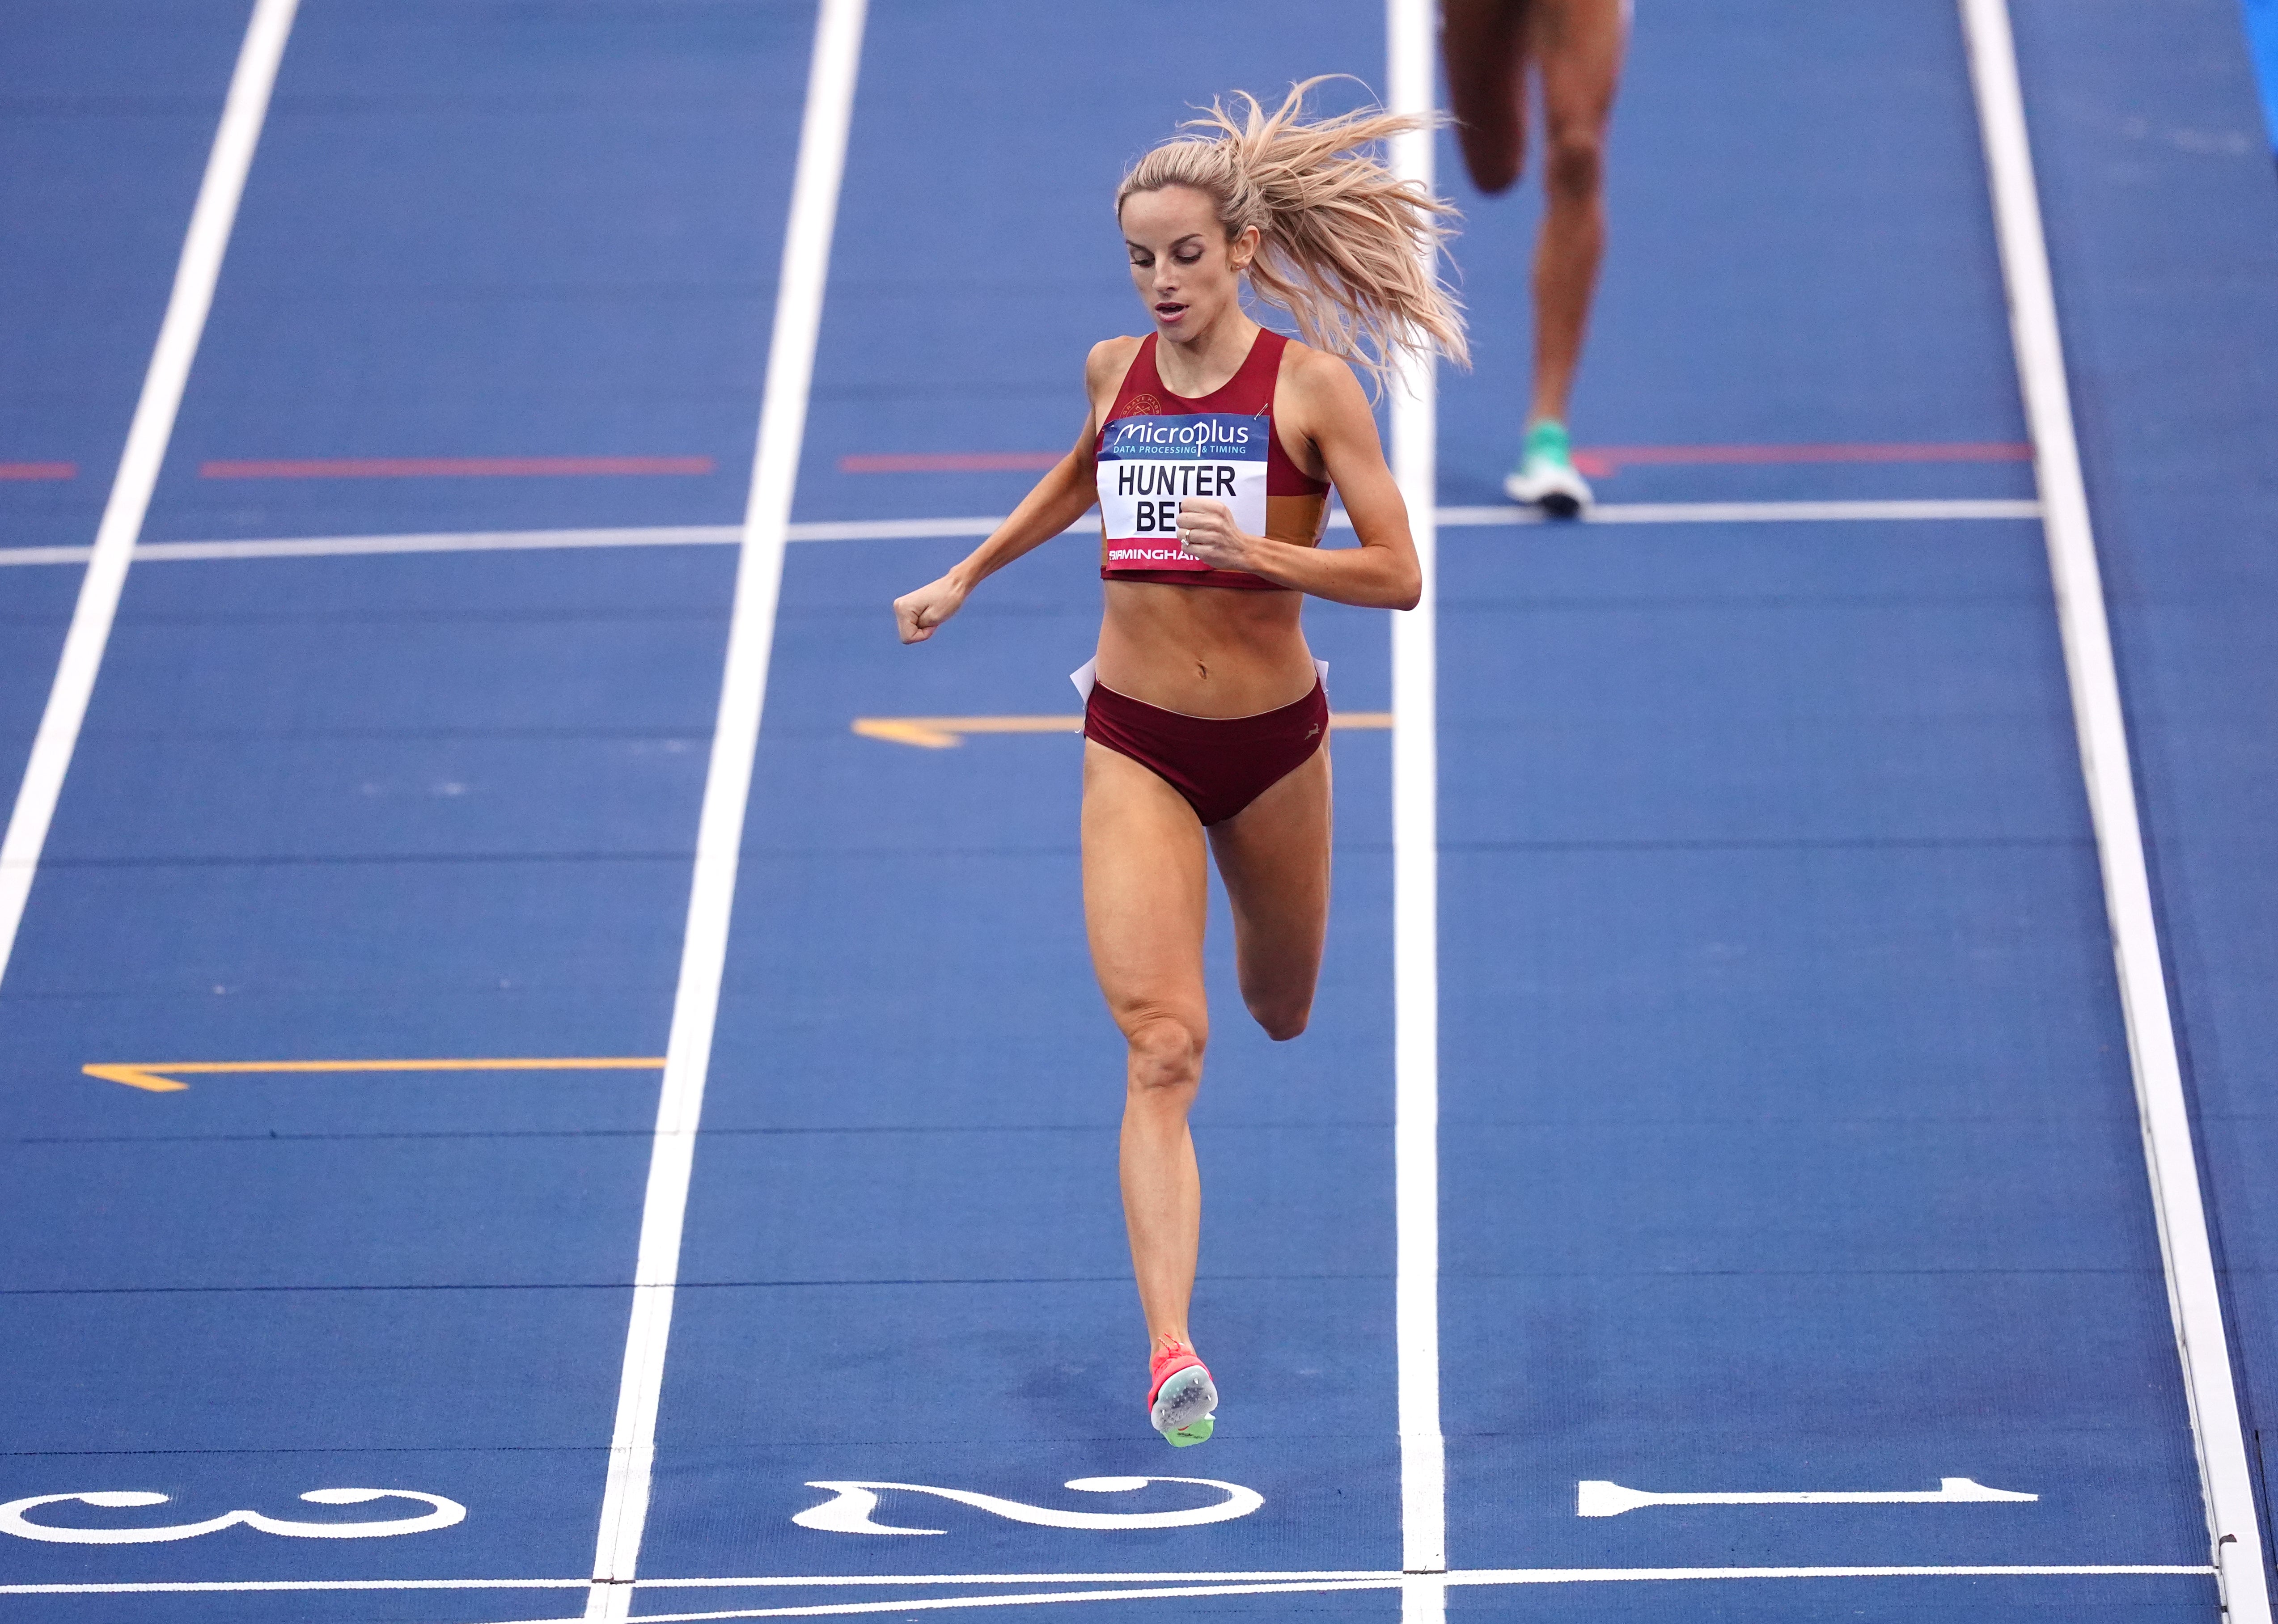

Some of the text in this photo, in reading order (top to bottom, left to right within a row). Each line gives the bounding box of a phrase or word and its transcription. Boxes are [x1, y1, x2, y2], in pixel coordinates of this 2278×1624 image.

[1122, 396, 1160, 418] GRAVE HARR
[1114, 419, 1249, 457] Microplus
[1114, 445, 1136, 453] DATA
[1210, 445, 1246, 454] TIMING
[1118, 465, 1236, 496] HUNTER
[1137, 501, 1182, 532] BE
[792, 1476, 1266, 1535] 2
[1575, 1477, 2039, 1517] 1
[0, 1488, 466, 1544] 3
